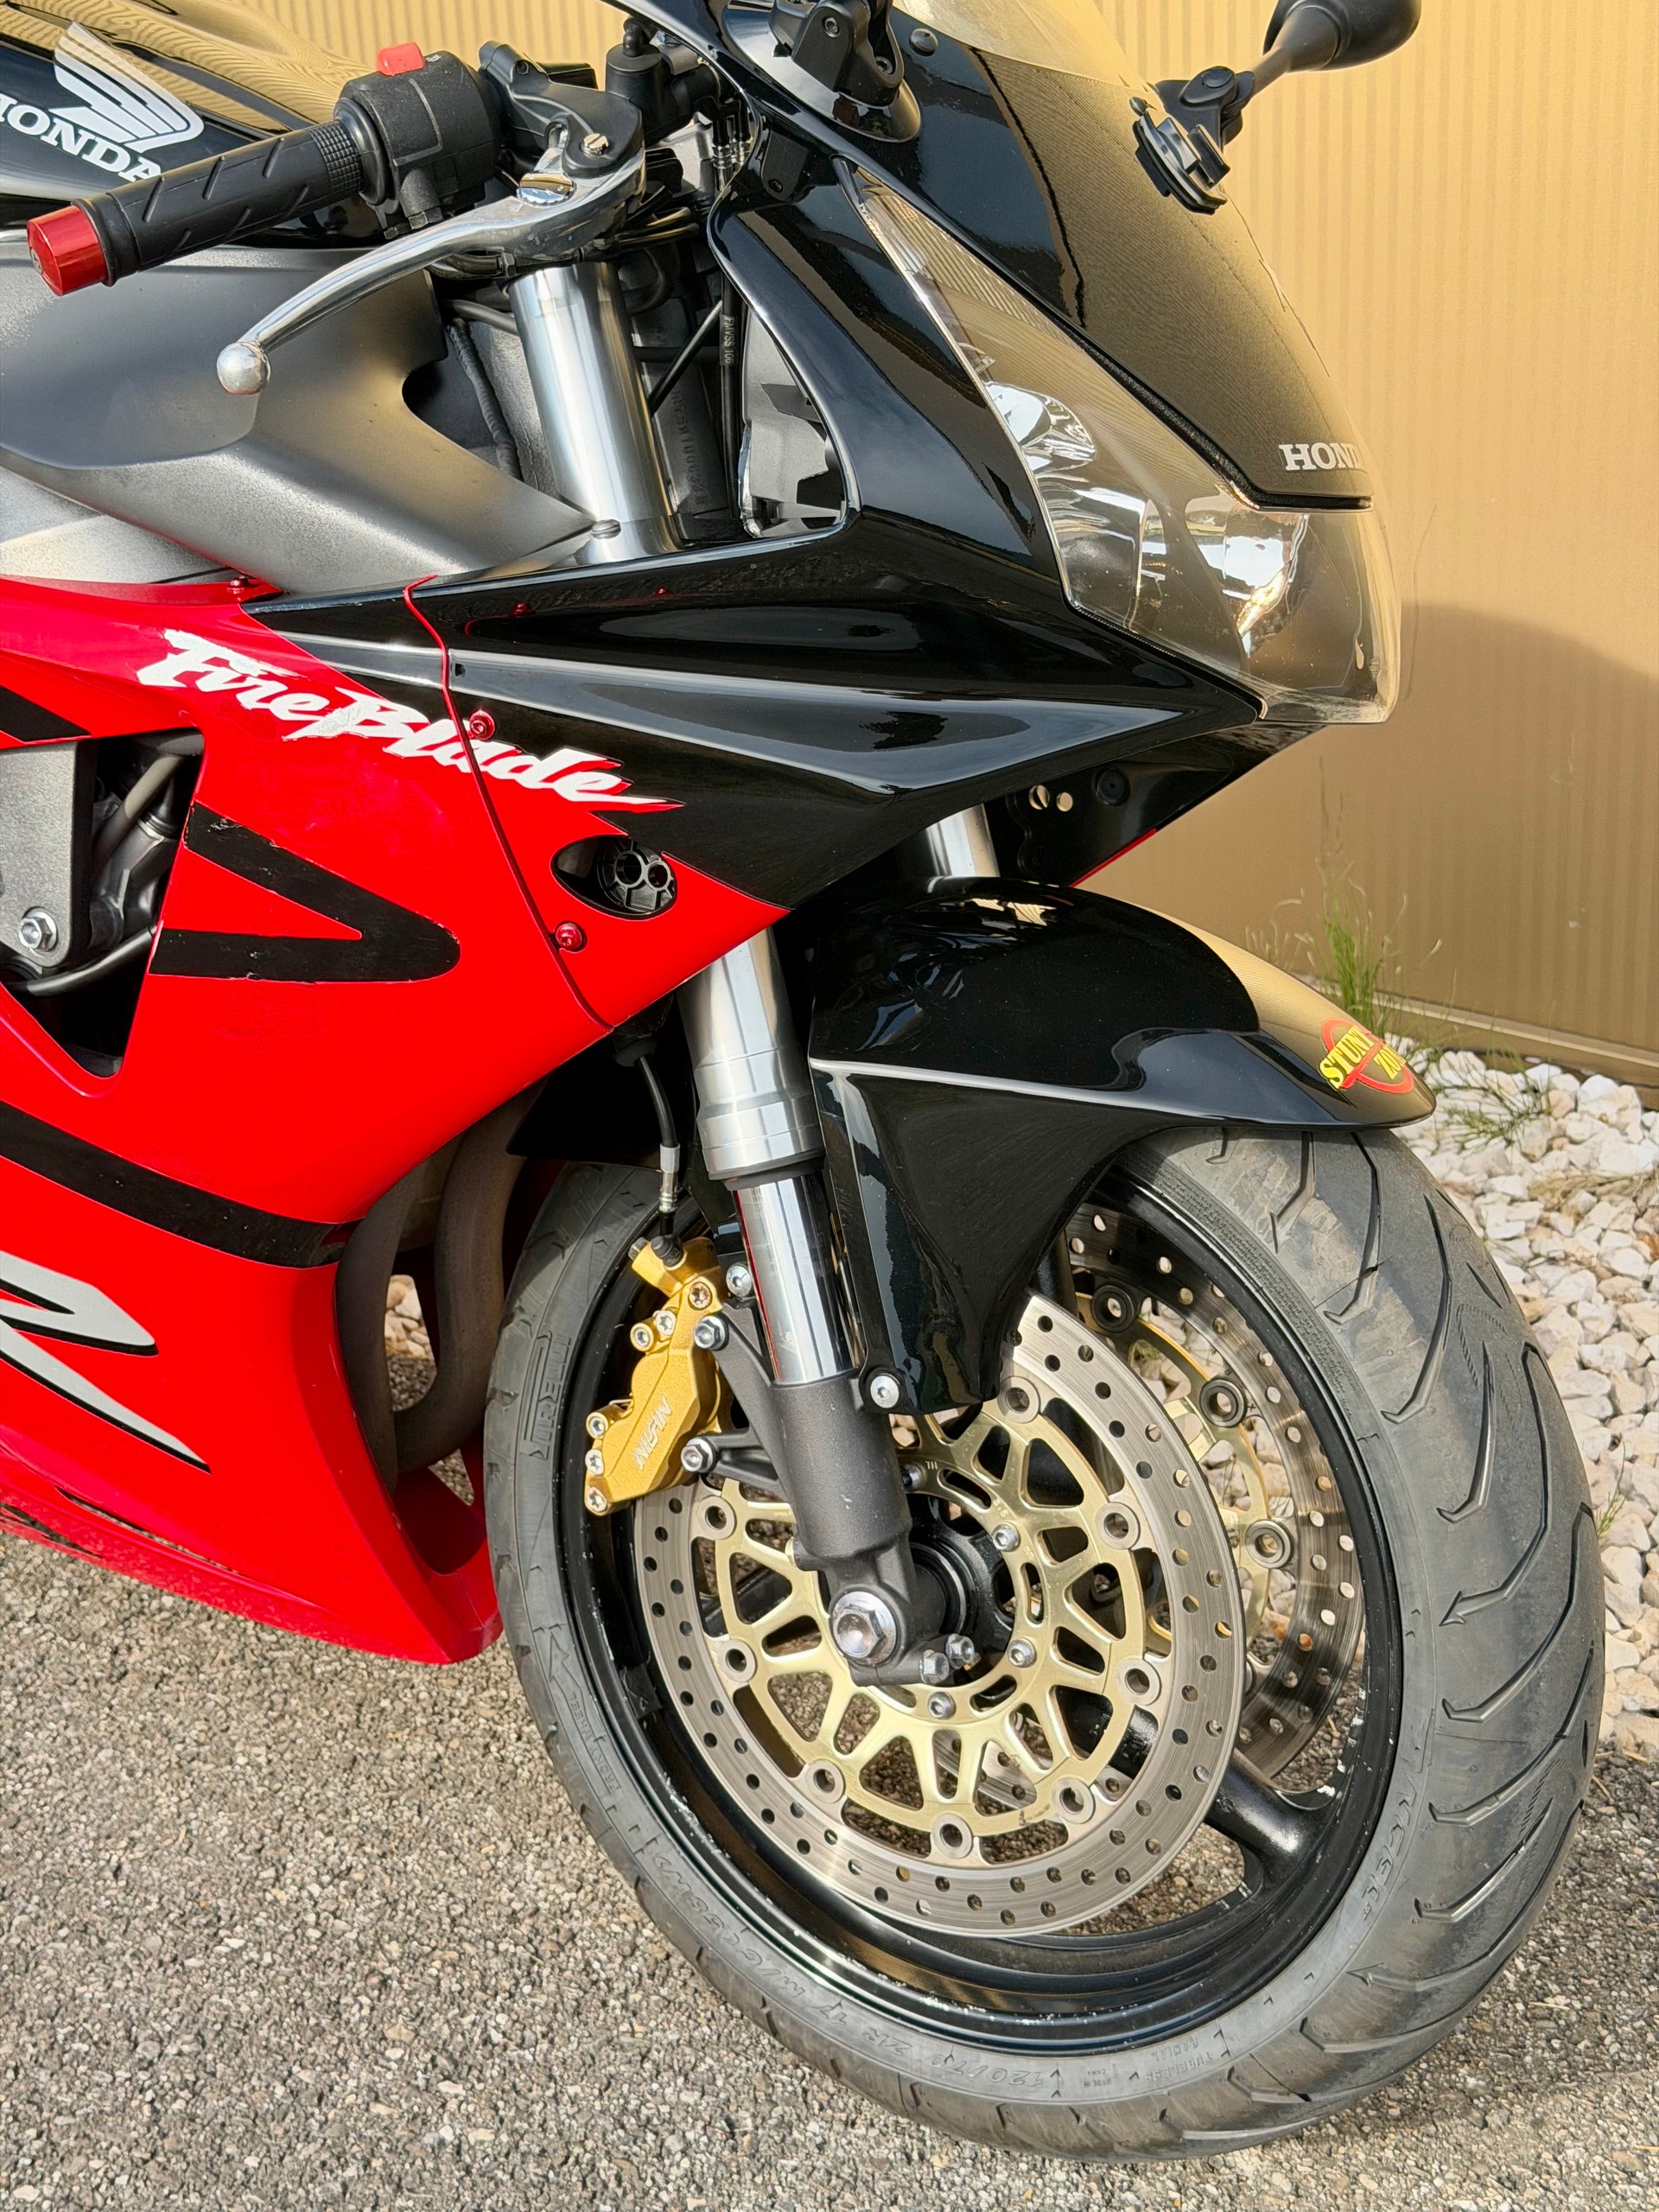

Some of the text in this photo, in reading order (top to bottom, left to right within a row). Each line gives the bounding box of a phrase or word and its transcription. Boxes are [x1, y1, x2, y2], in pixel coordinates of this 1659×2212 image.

[1319, 1026, 1375, 1090] STUNT
[569, 1691, 622, 1791] FRONT WHEEL
